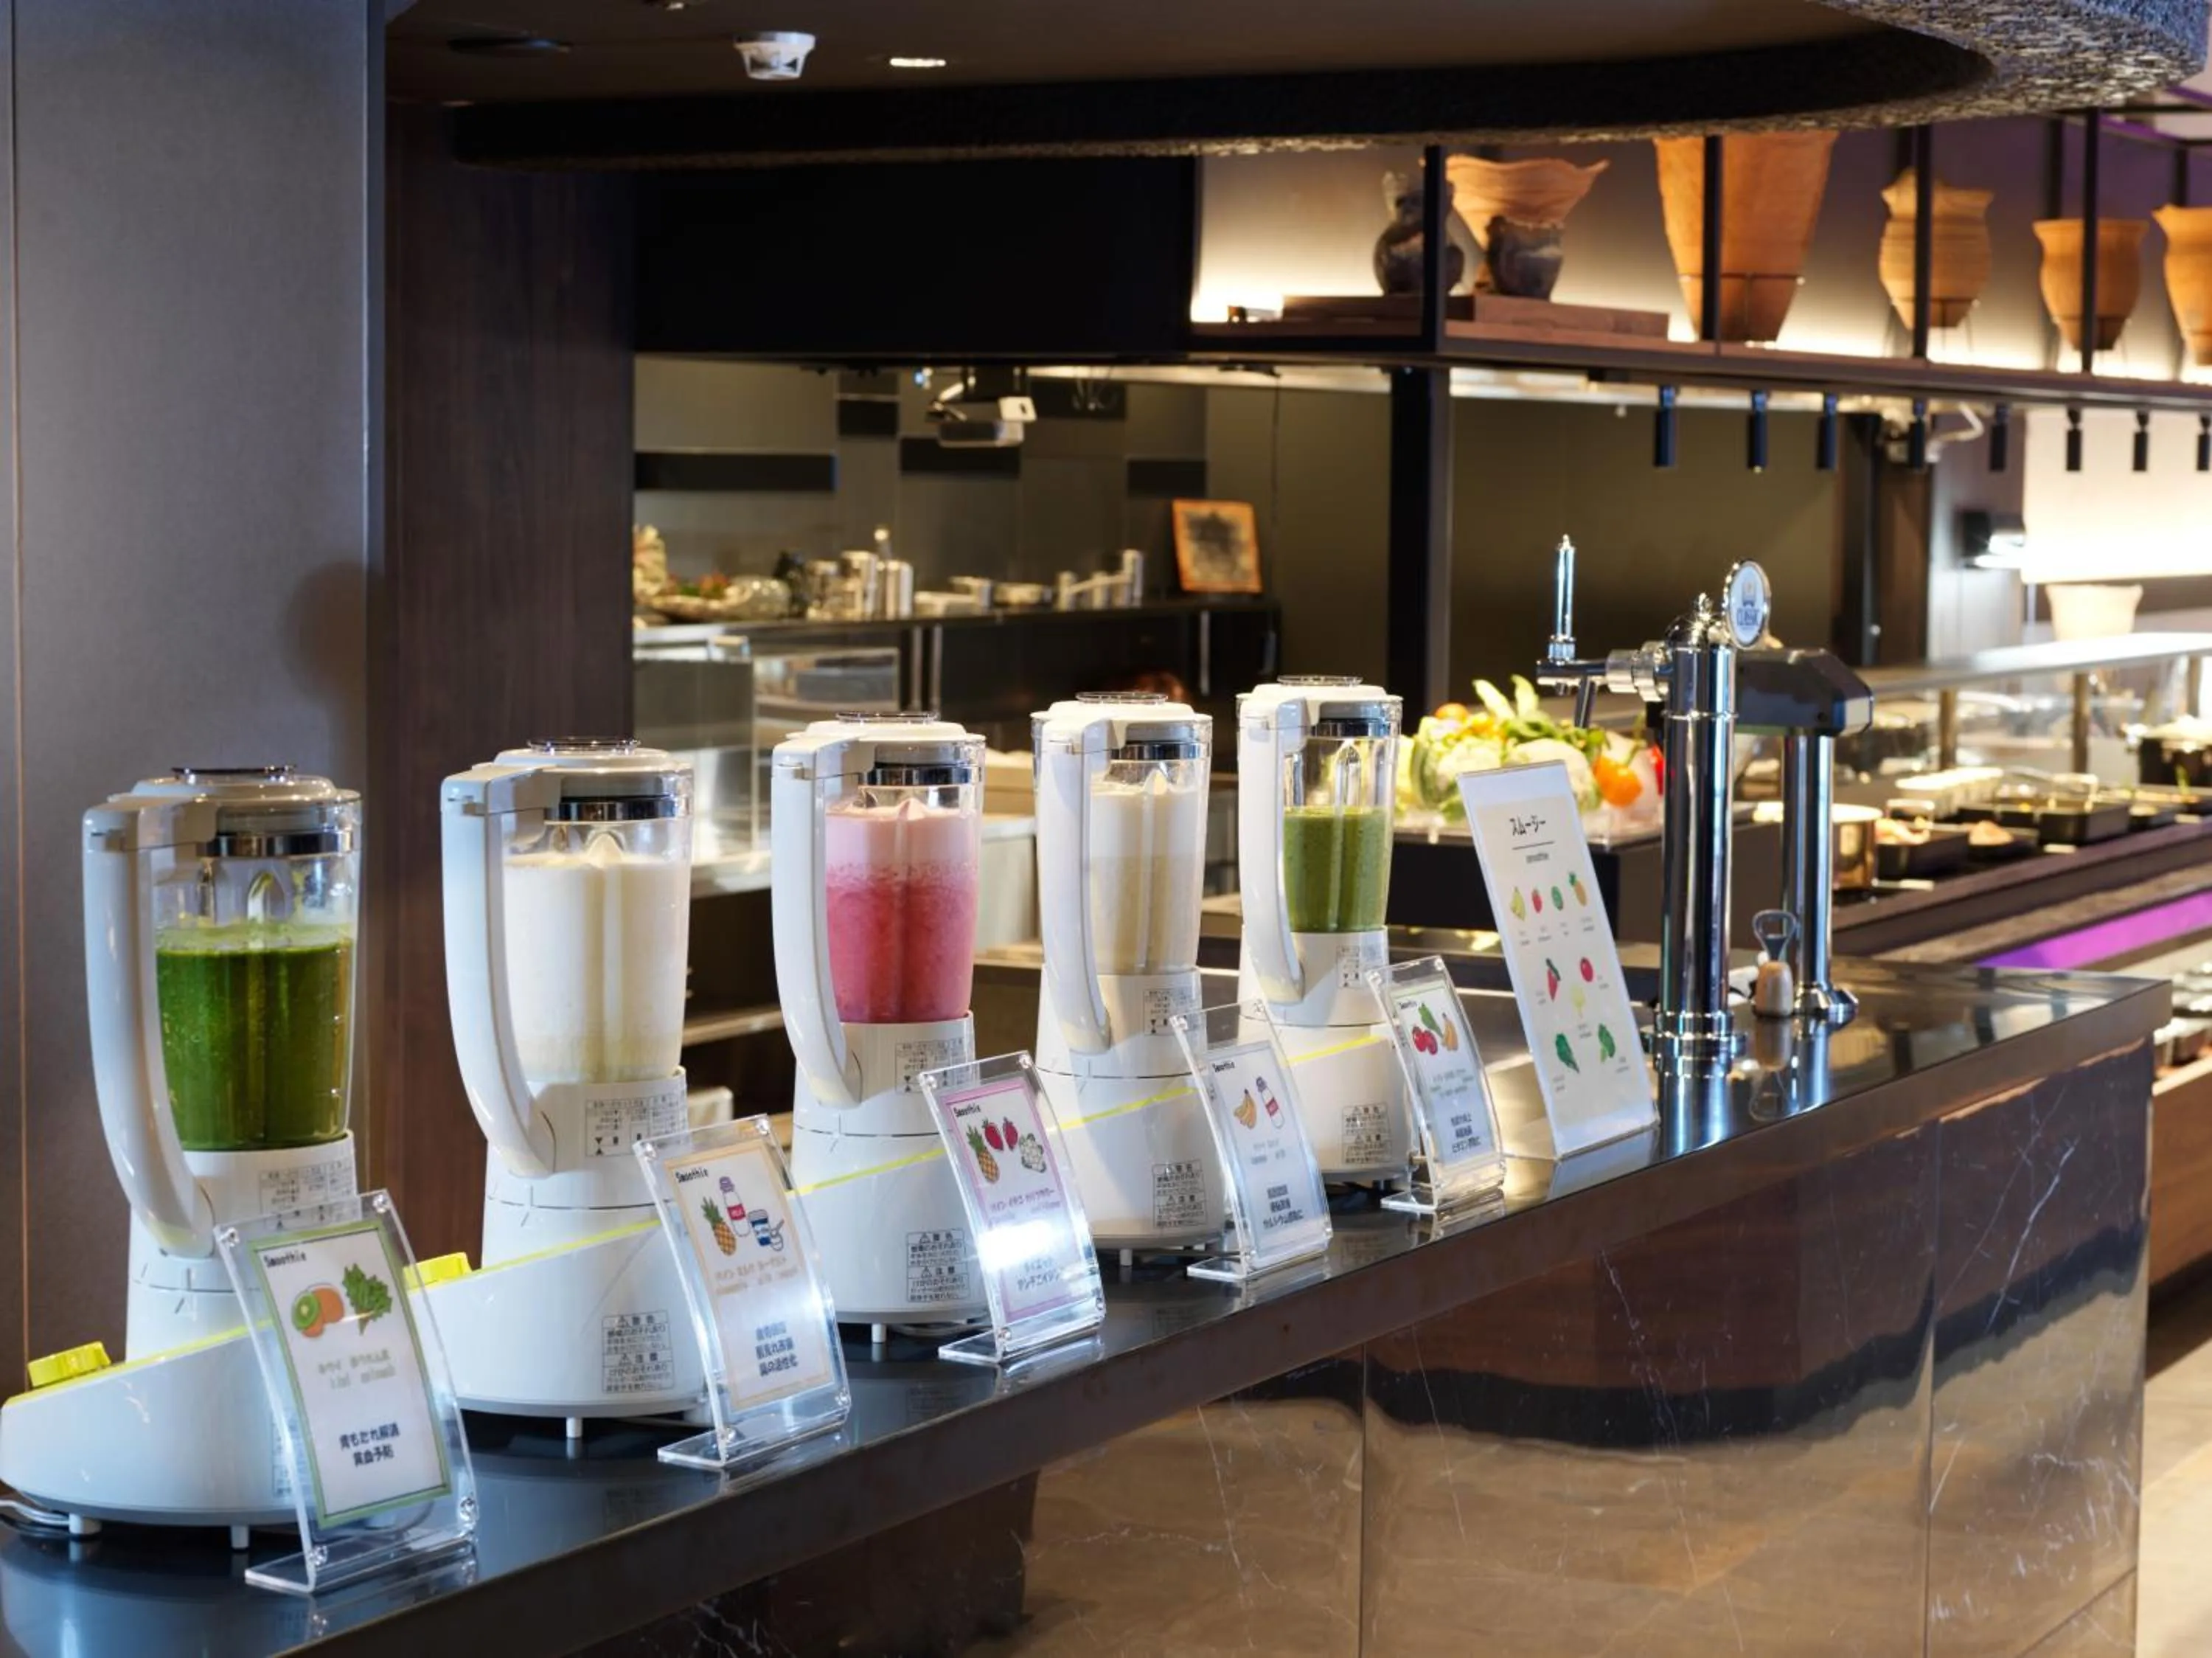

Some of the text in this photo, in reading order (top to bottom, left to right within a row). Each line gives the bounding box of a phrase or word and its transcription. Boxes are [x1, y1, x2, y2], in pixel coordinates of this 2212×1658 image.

[1509, 814, 1546, 836] スムージー
[675, 1168, 709, 1183] Smoothie
[263, 1252, 307, 1268] Smoothie
